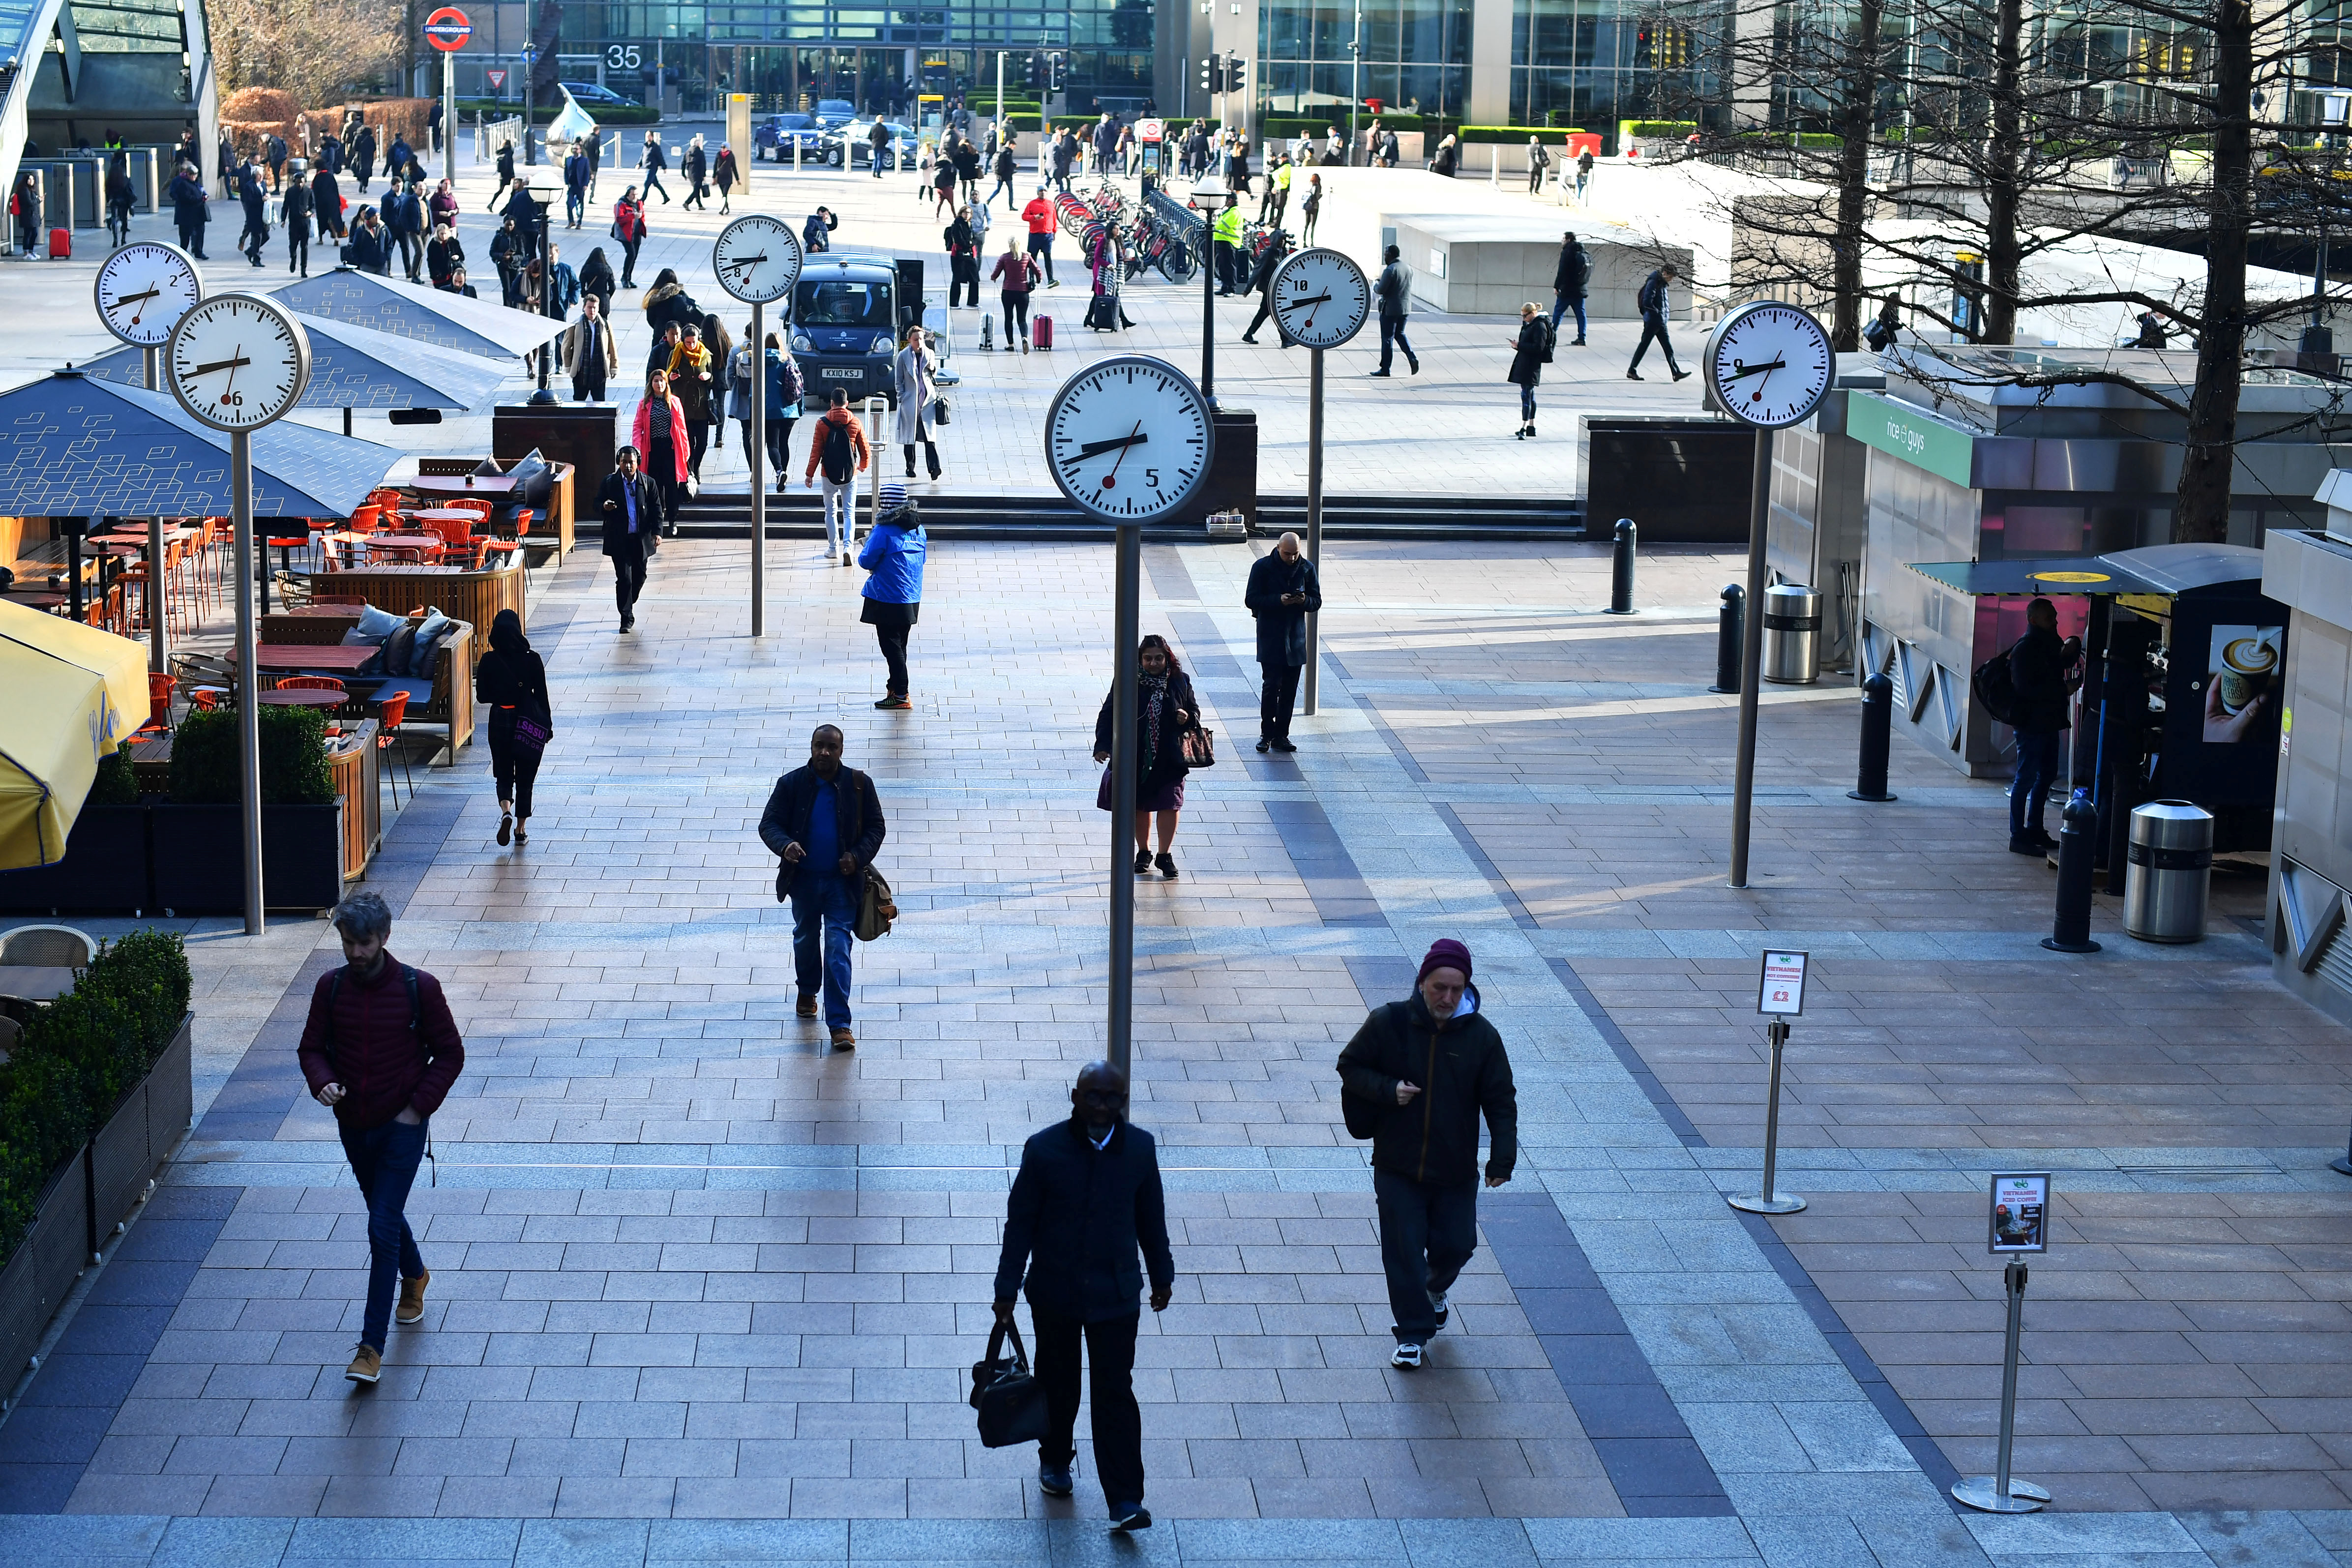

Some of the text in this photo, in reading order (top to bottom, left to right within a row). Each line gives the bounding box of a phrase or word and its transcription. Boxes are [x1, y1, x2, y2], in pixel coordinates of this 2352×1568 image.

[607, 45, 641, 69] 35
[169, 274, 179, 287] 2
[734, 267, 741, 278] 8
[1293, 279, 1308, 292] 10
[1733, 358, 1743, 373] 9
[232, 390, 243, 407] 6
[1887, 416, 1924, 454] rice guys
[1146, 468, 1159, 487] 5
[516, 720, 545, 740] LSBSU
[1773, 991, 1789, 1002] £2
